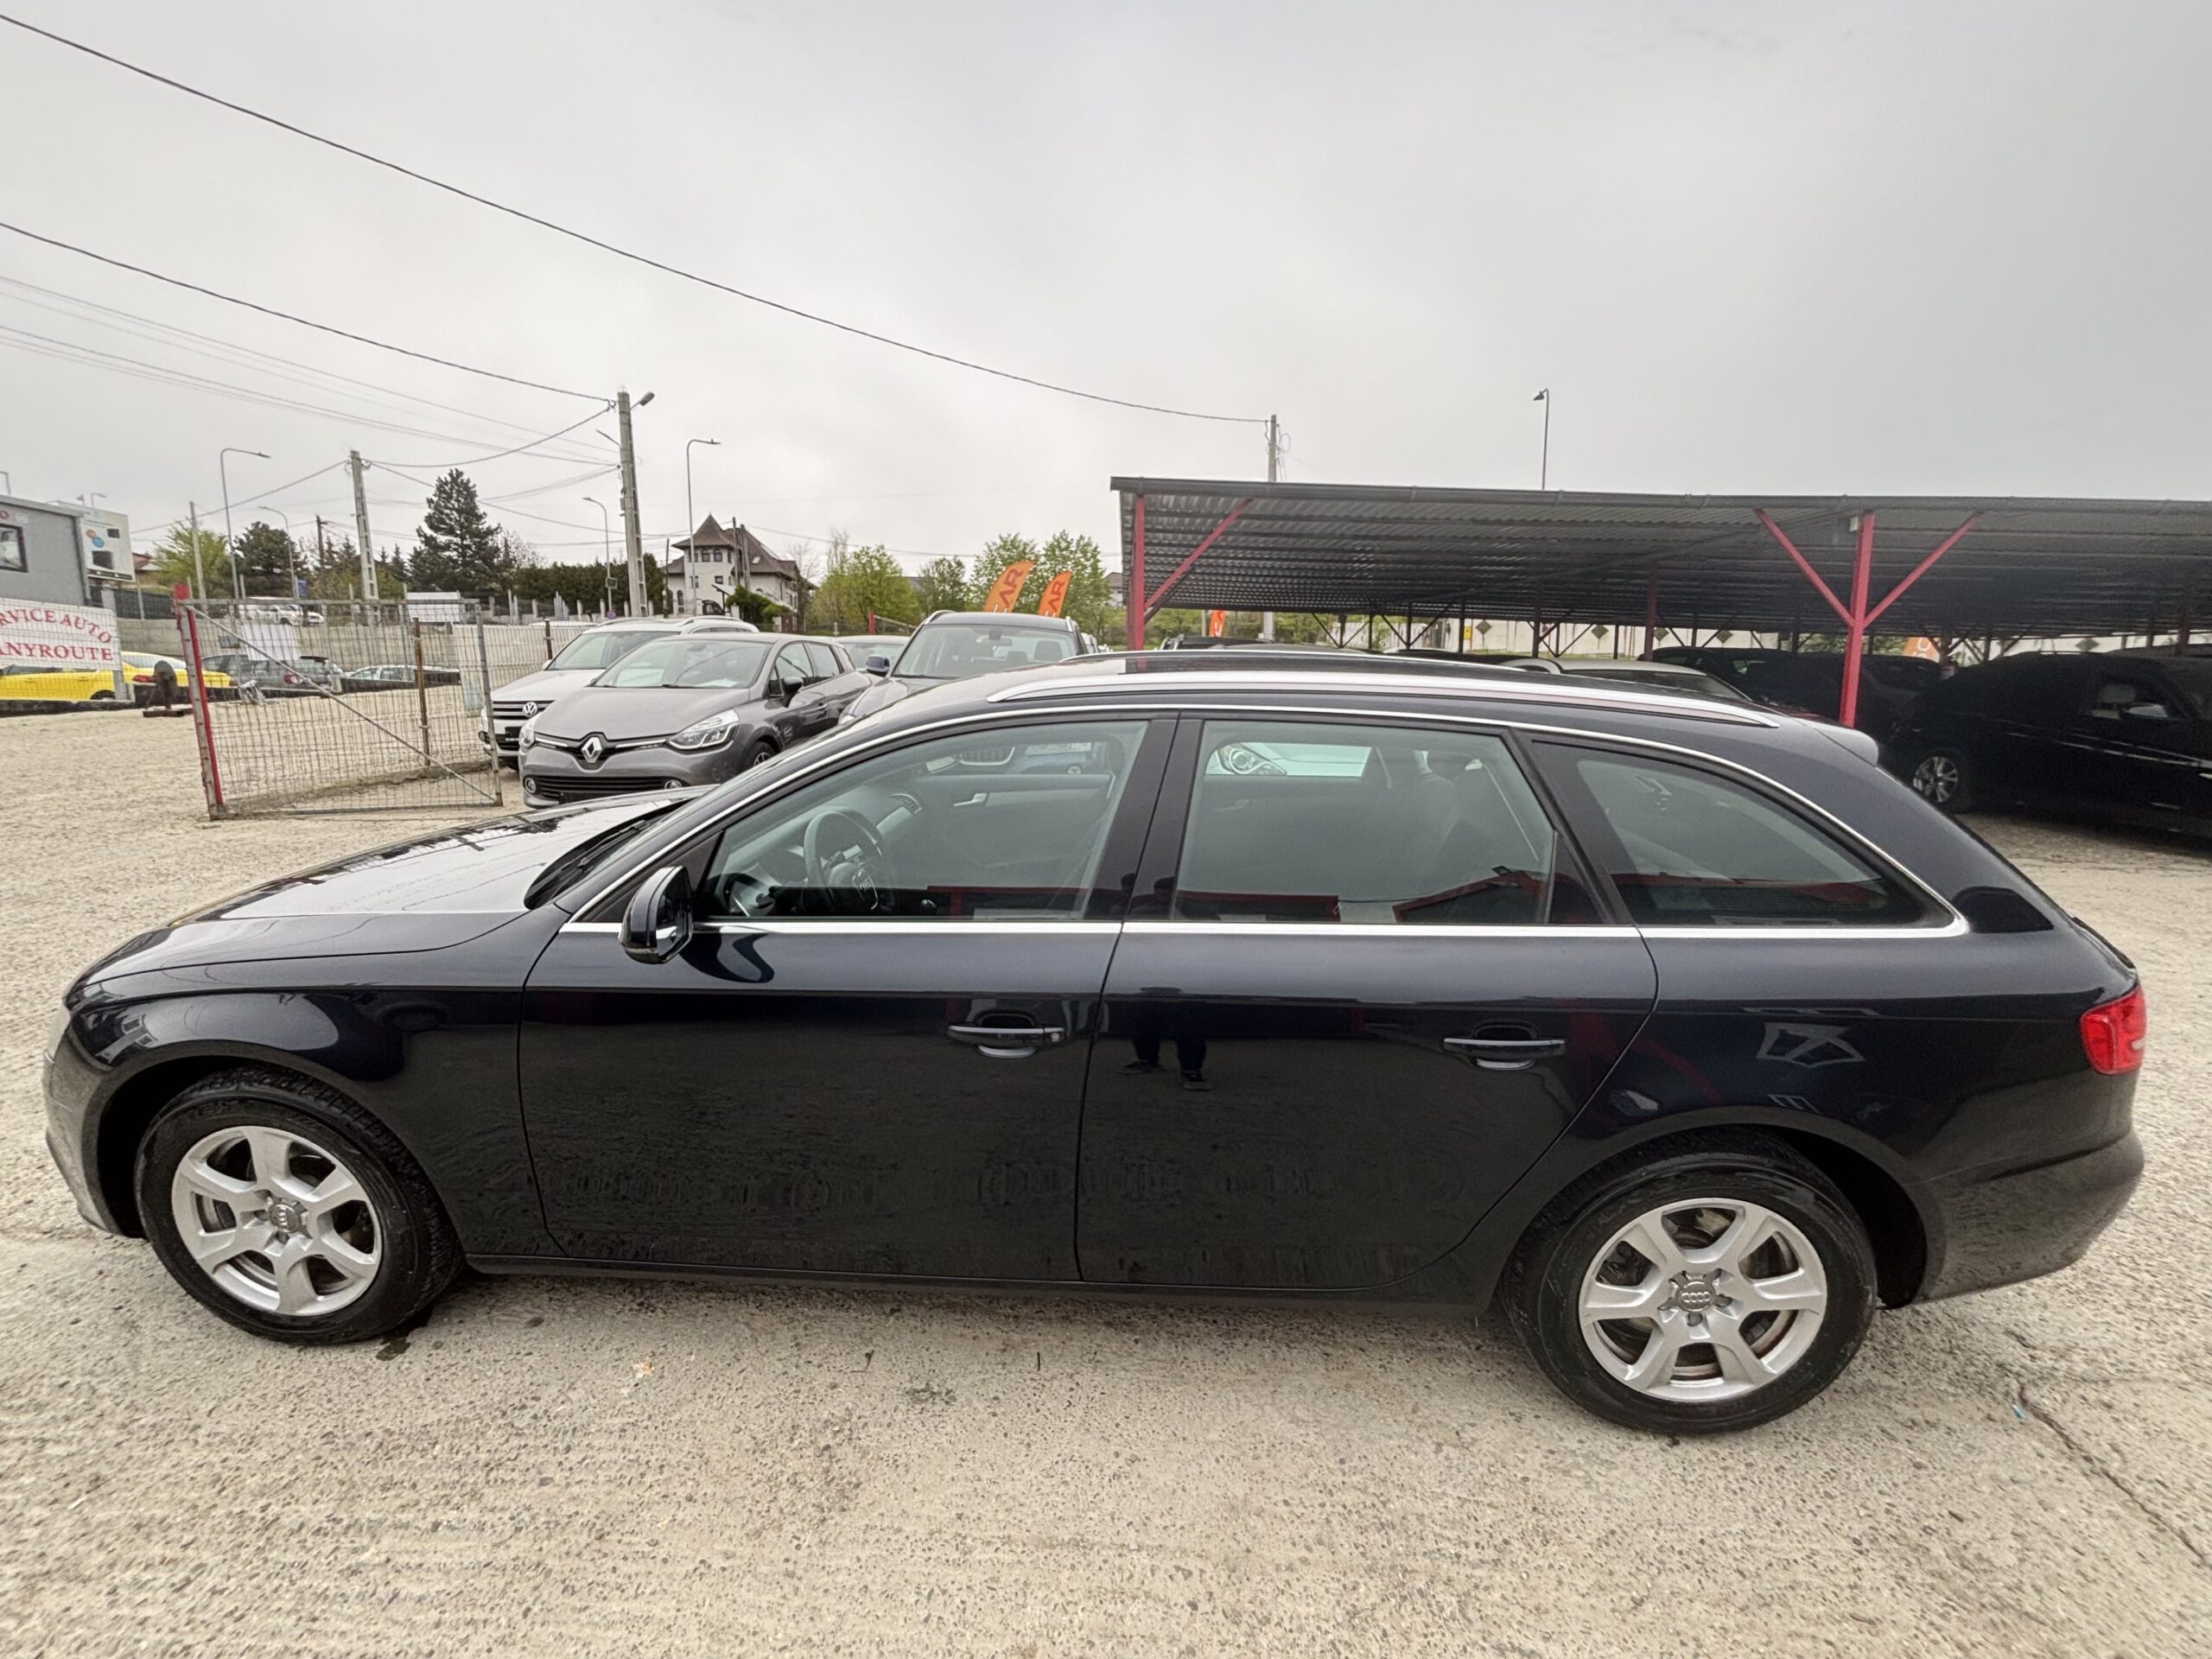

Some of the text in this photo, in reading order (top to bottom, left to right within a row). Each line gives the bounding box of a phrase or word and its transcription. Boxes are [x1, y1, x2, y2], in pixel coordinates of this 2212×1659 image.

[995, 569, 1023, 611] AR
[1046, 580, 1065, 614] AR
[60, 613, 112, 644] AUTO
